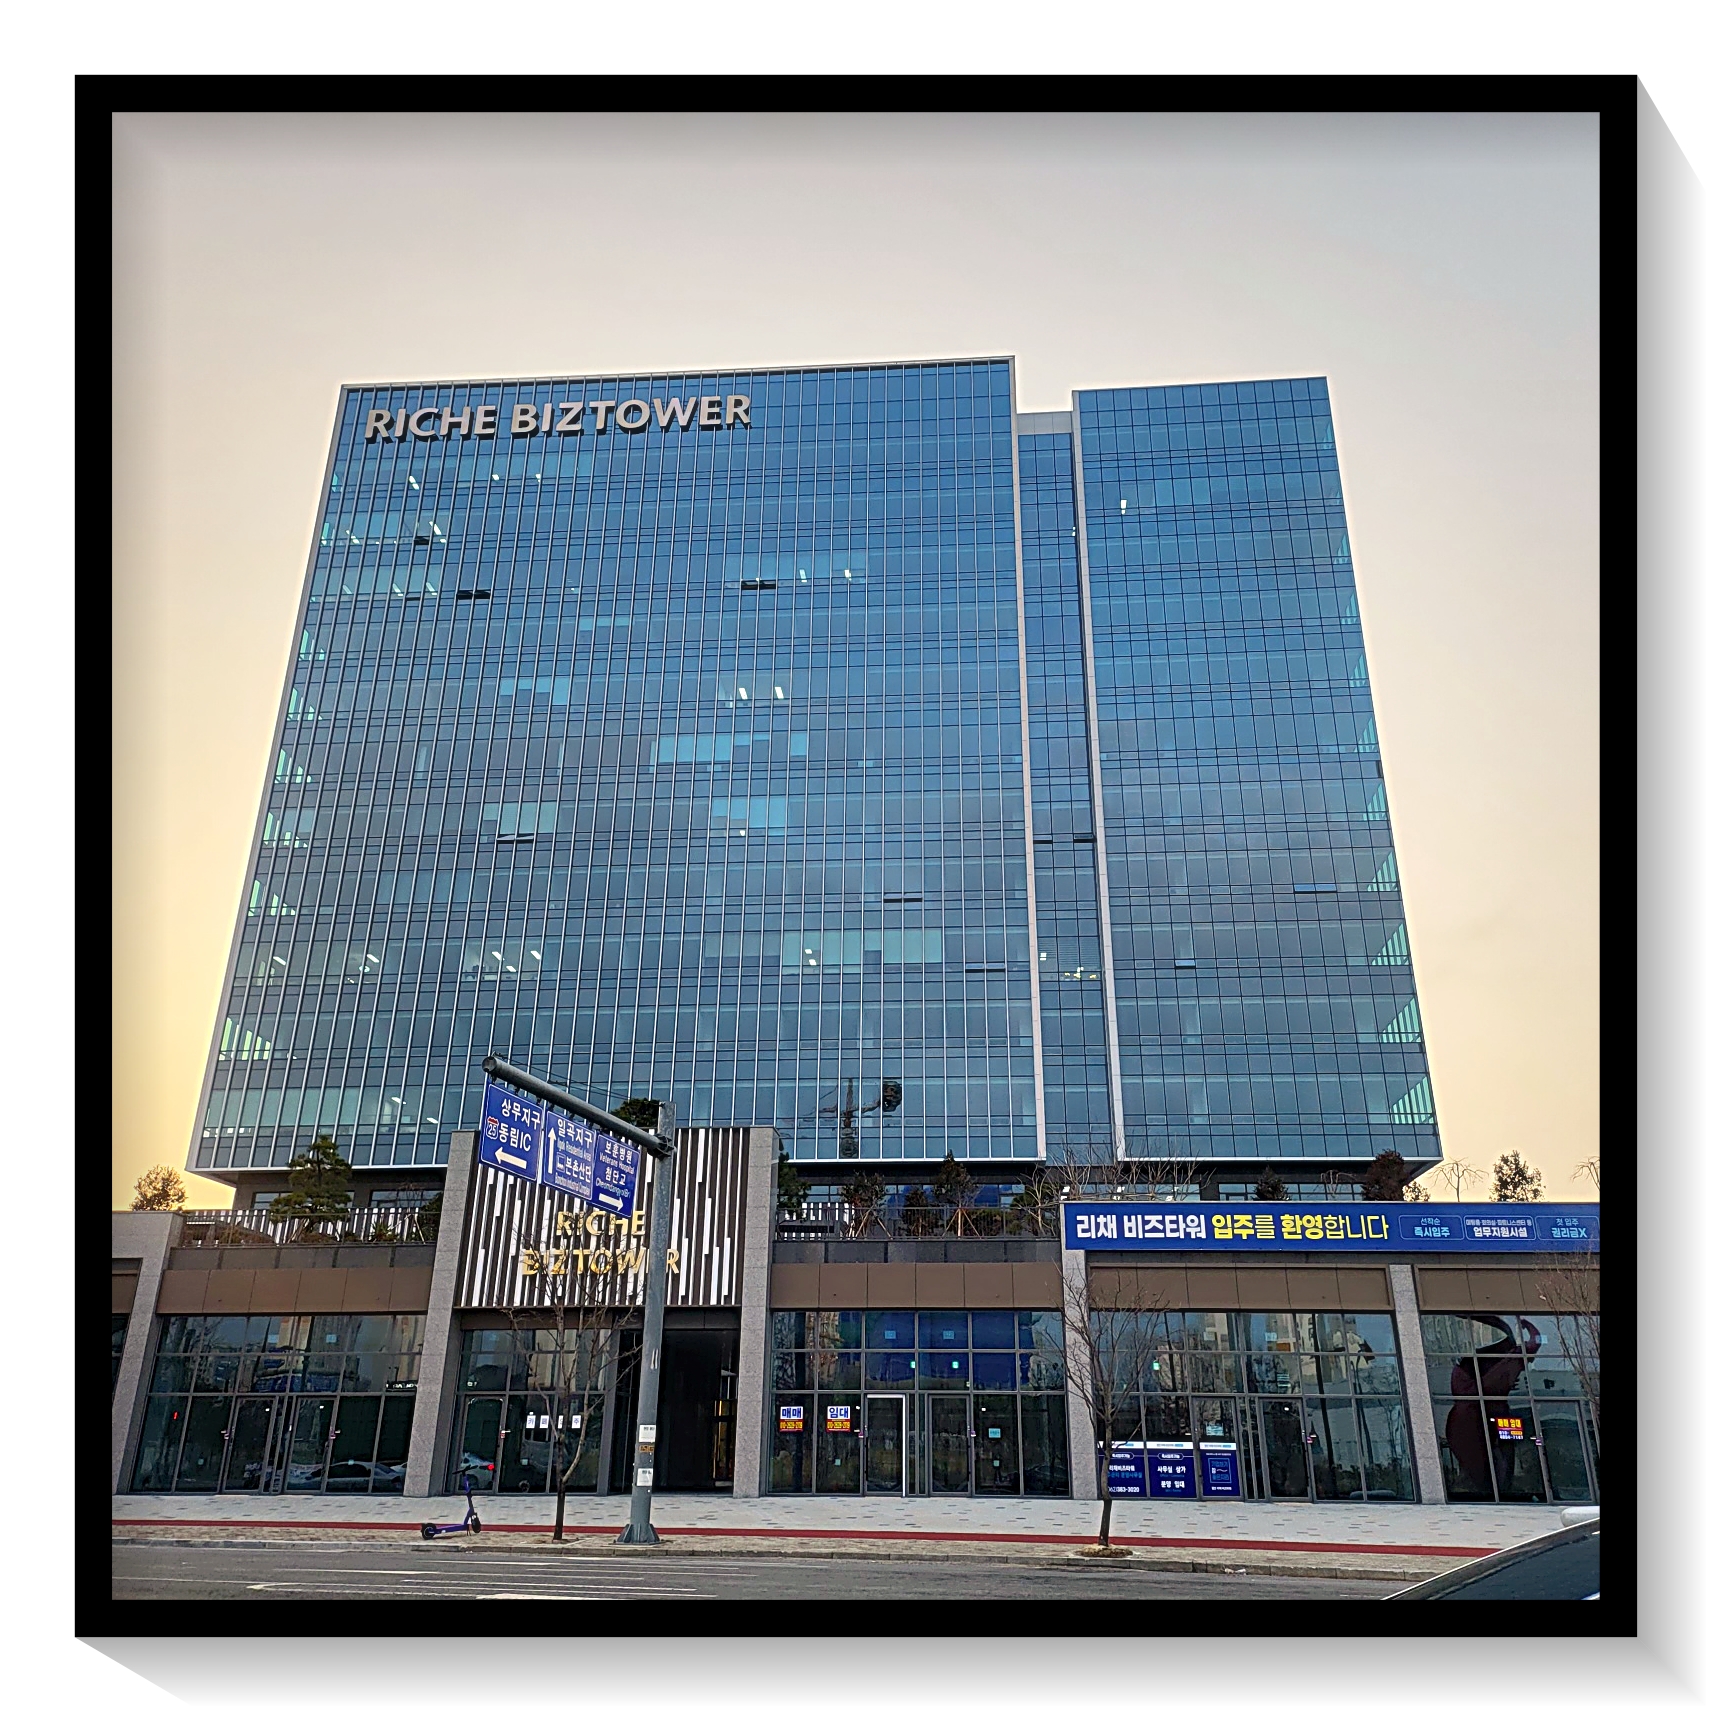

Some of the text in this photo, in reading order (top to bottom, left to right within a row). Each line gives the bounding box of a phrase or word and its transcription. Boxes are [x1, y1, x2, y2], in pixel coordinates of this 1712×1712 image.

[364, 395, 752, 440] RICHE BIZTOWER
[501, 1098, 541, 1130] 상무지구
[488, 1123, 497, 1137] 25
[499, 1122, 532, 1152] 동림IC
[557, 1118, 593, 1149] 일곡지구
[605, 1140, 633, 1165] 보훈병원
[565, 1156, 592, 1183] 본촌산단
[605, 1166, 626, 1186] 첨단교
[556, 1210, 646, 1236] RICHE
[1076, 1214, 1389, 1240] 리채 비즈타워 입주를 환영합니다
[1420, 1217, 1441, 1226] 선착순
[1556, 1217, 1579, 1227] 첫 입주
[1414, 1226, 1450, 1238] 즉시입주
[1473, 1226, 1528, 1238] 업무지원시설
[1551, 1227, 1588, 1238] 권리금X
[522, 1248, 680, 1275] BIZTOWR
[782, 1407, 802, 1418] 매매
[829, 1407, 849, 1418] 임대
[1157, 1465, 1187, 1474] 사무실 상가
